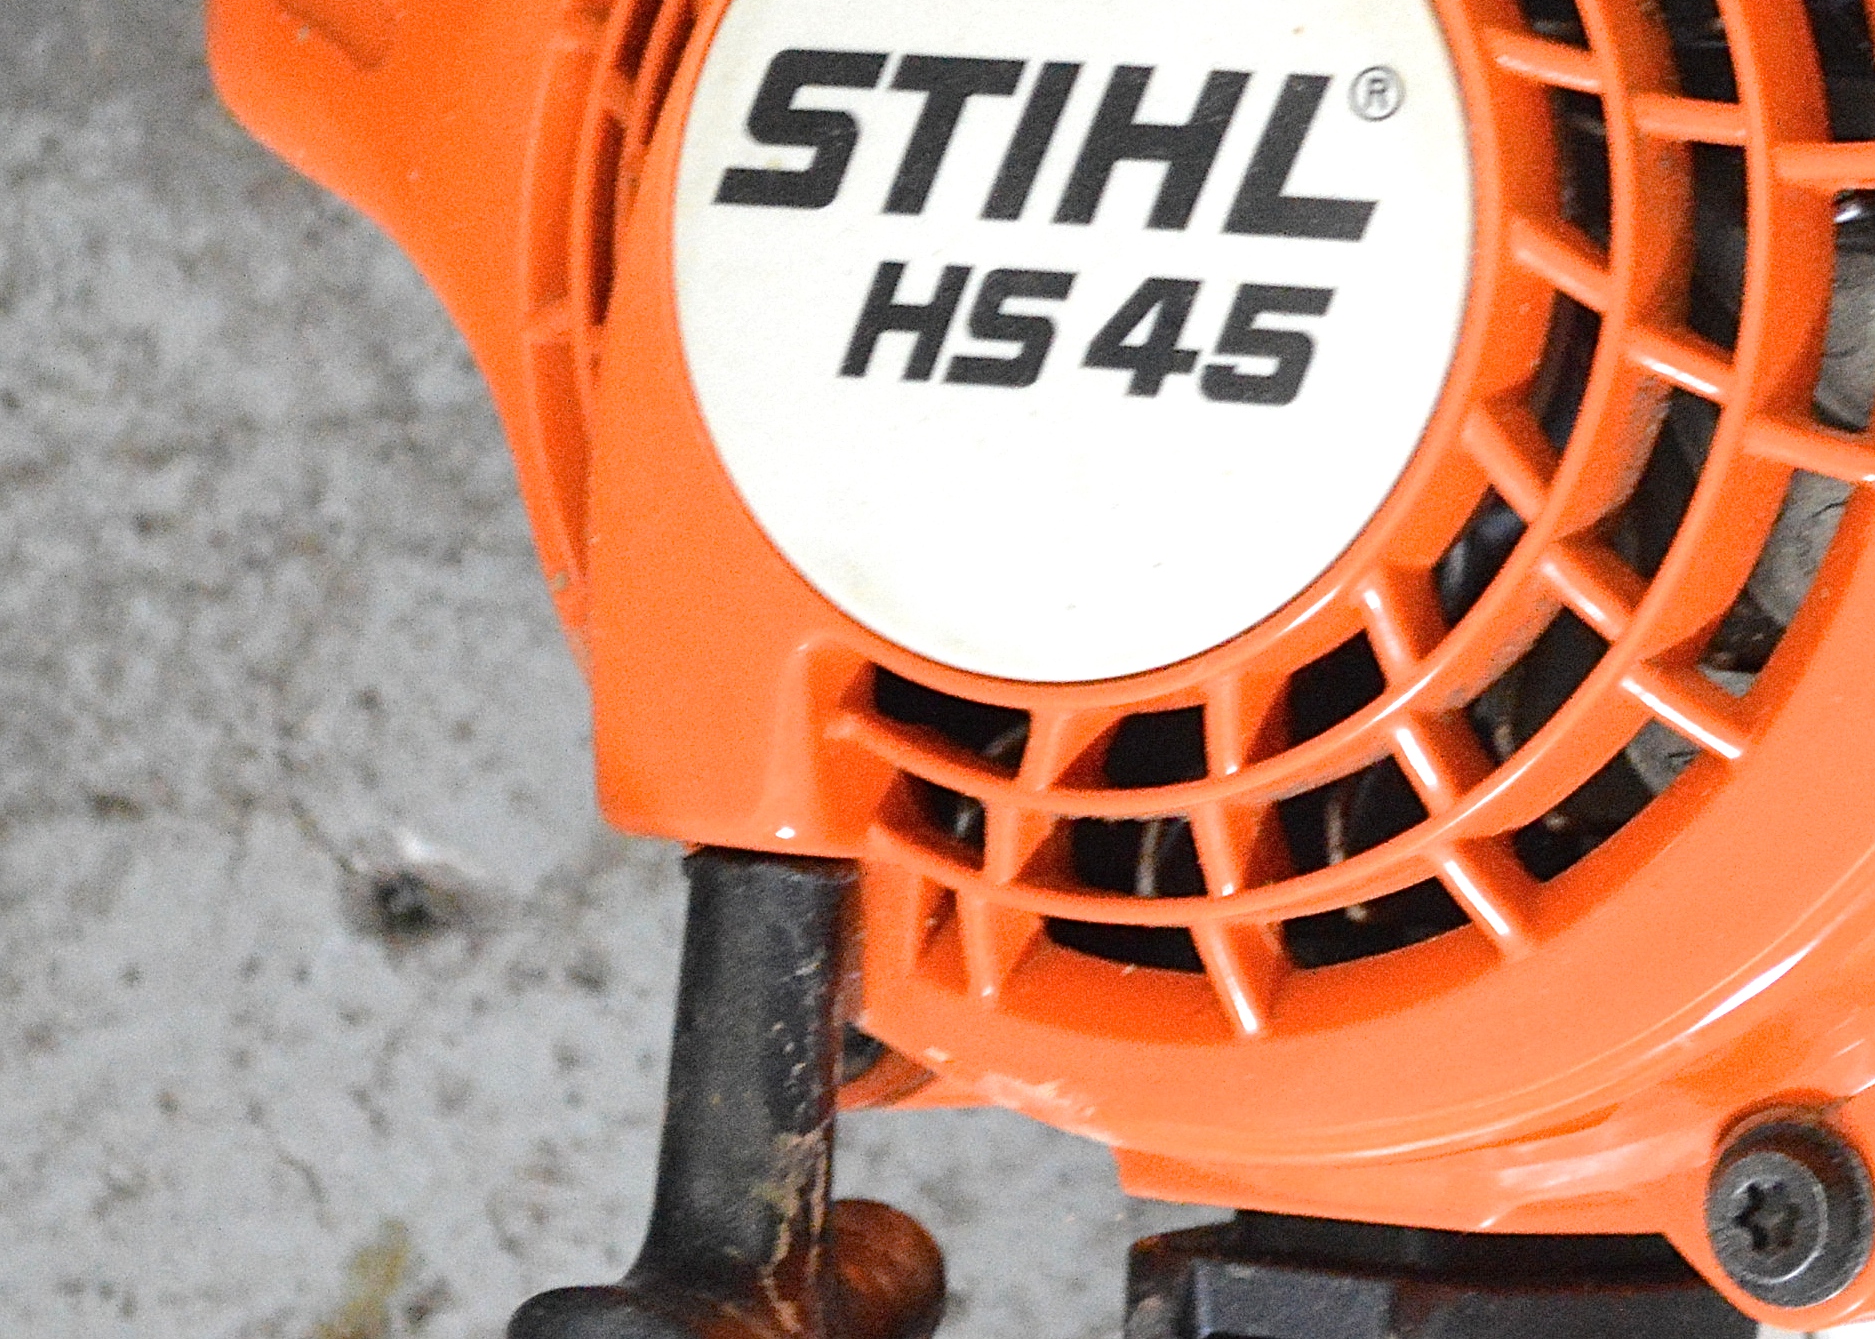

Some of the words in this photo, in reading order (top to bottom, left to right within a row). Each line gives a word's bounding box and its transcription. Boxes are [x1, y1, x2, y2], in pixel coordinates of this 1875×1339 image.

[713, 47, 1378, 242] STIHL
[839, 260, 1078, 388] HS
[1081, 276, 1334, 406] 45
